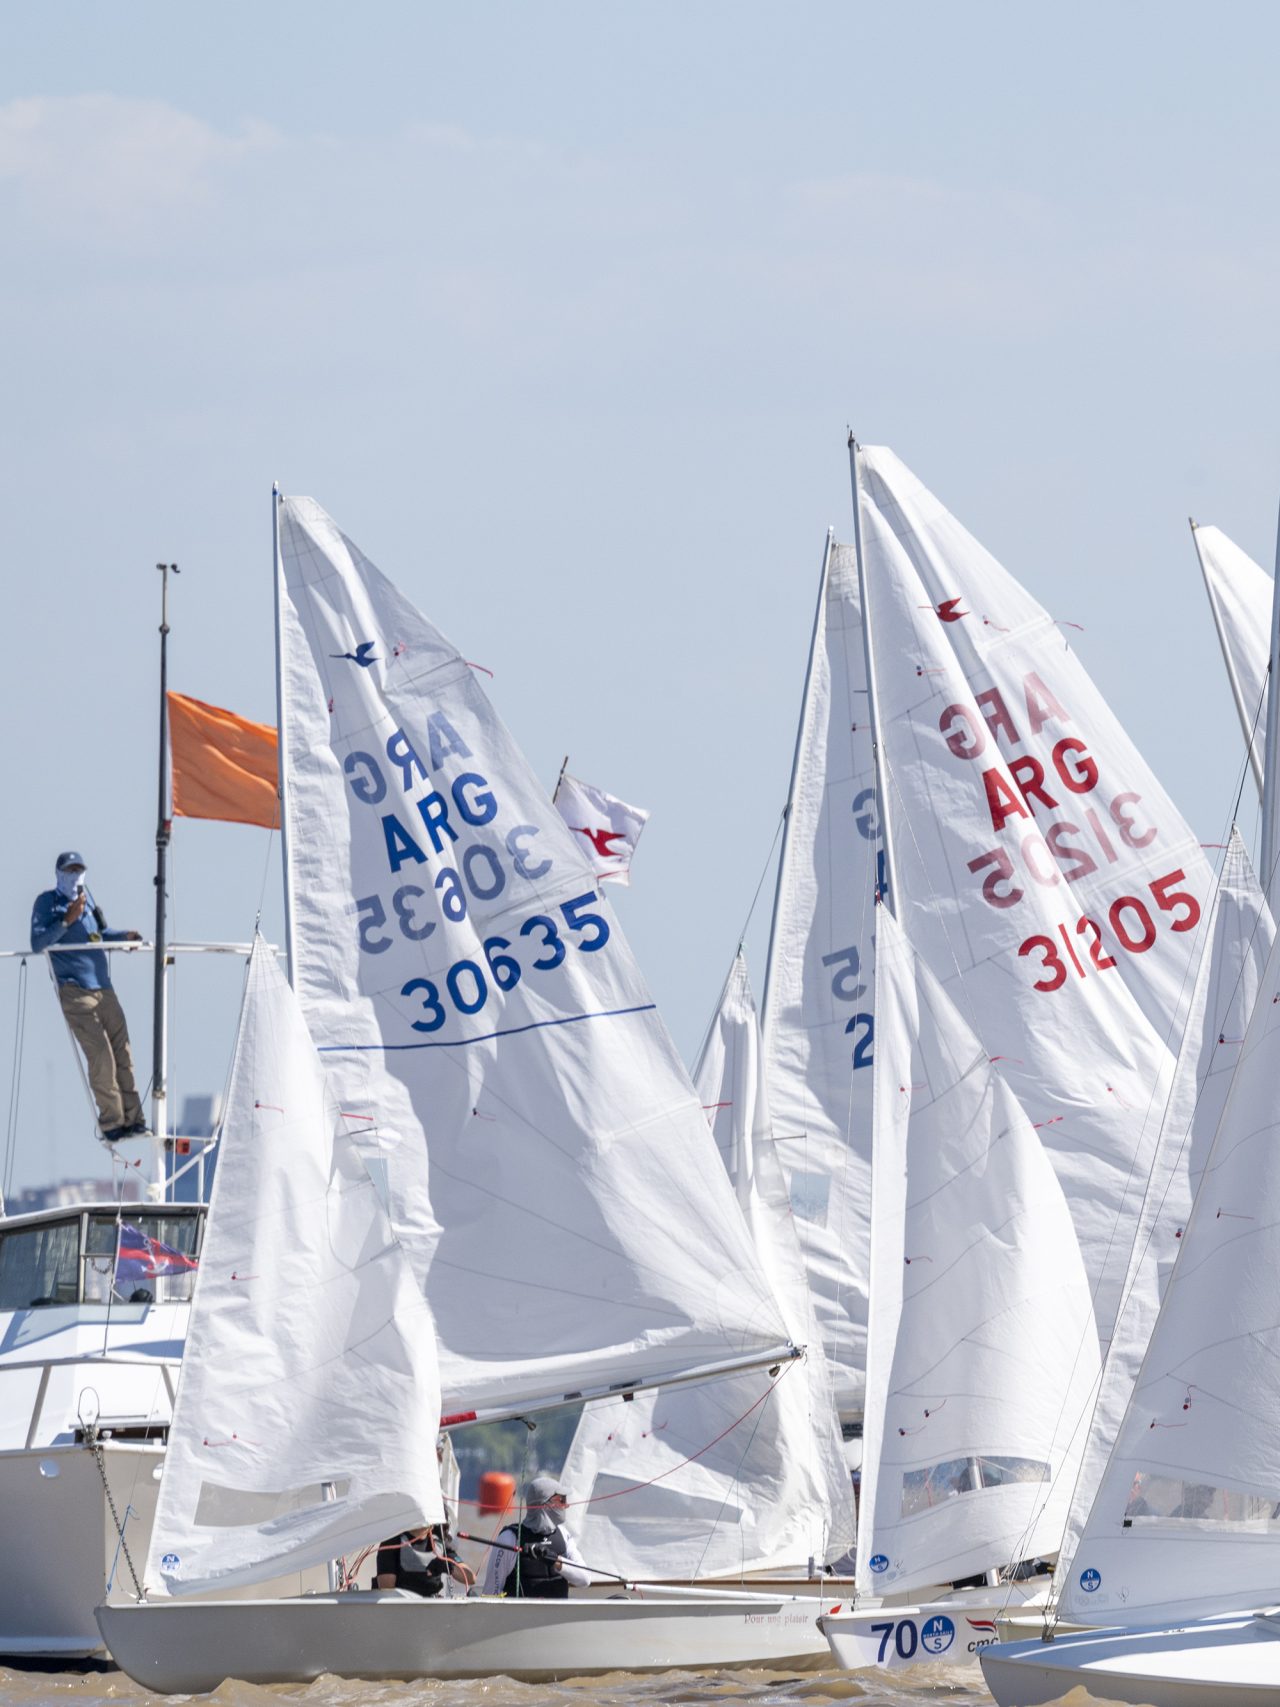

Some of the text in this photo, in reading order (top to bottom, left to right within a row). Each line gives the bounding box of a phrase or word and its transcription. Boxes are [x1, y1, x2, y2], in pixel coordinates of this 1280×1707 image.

[380, 772, 499, 874] ARG
[982, 737, 1099, 833] ARG
[400, 891, 610, 1033] 30635
[1018, 868, 1201, 993] 31205
[870, 1619, 918, 1662] 70
